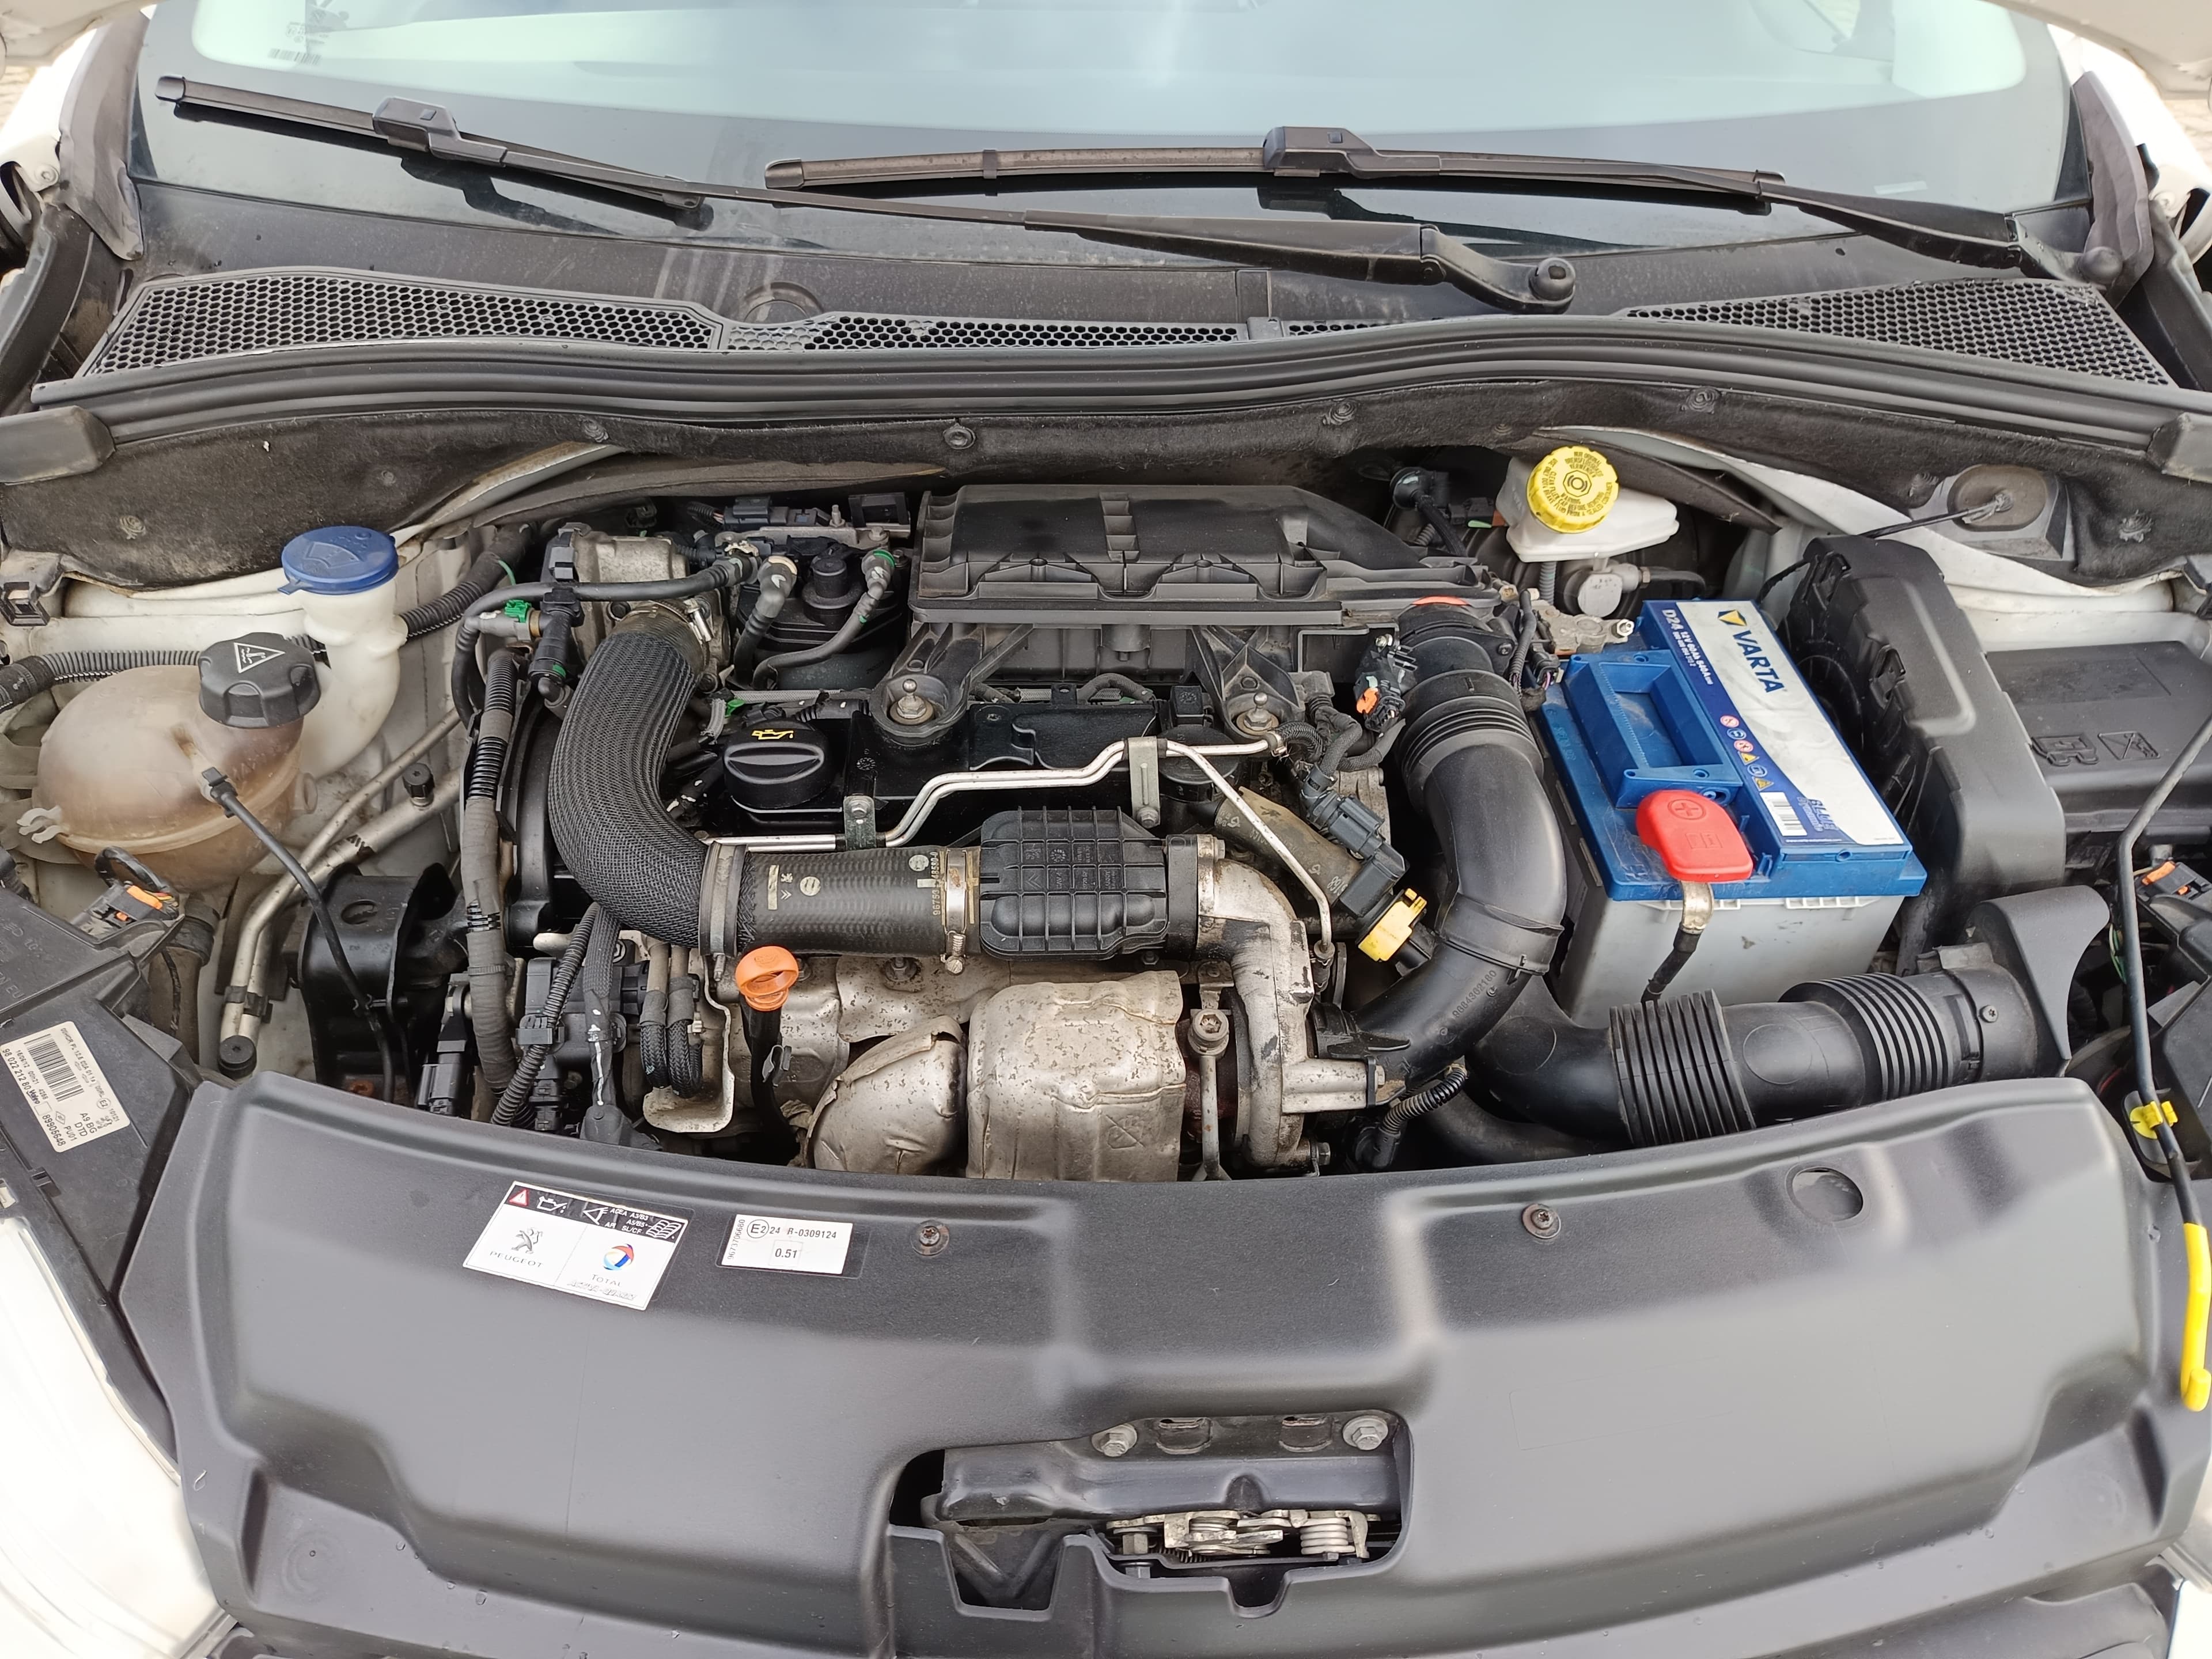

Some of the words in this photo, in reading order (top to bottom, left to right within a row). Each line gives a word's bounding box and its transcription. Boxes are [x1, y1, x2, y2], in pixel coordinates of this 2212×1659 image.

[1662, 609, 1684, 631] D24
[1732, 630, 1785, 693] VARTA
[2, 1047, 13, 1057] 98
[7, 1056, 20, 1069] 022
[14, 1068, 27, 1081] 212
[74, 1121, 88, 1137] DTD
[79, 1111, 90, 1122] A9
[85, 1122, 97, 1134] BG
[610, 1208, 627, 1217] ACEA
[630, 1213, 649, 1221] A3/B3
[622, 1225, 642, 1234] SL/CF
[770, 1226, 781, 1234] 24
[787, 1228, 837, 1238] R-0309124
[490, 1250, 543, 1268] PEUGEOT
[775, 1248, 798, 1259] 0.51
[590, 1274, 622, 1287] TOTAL
